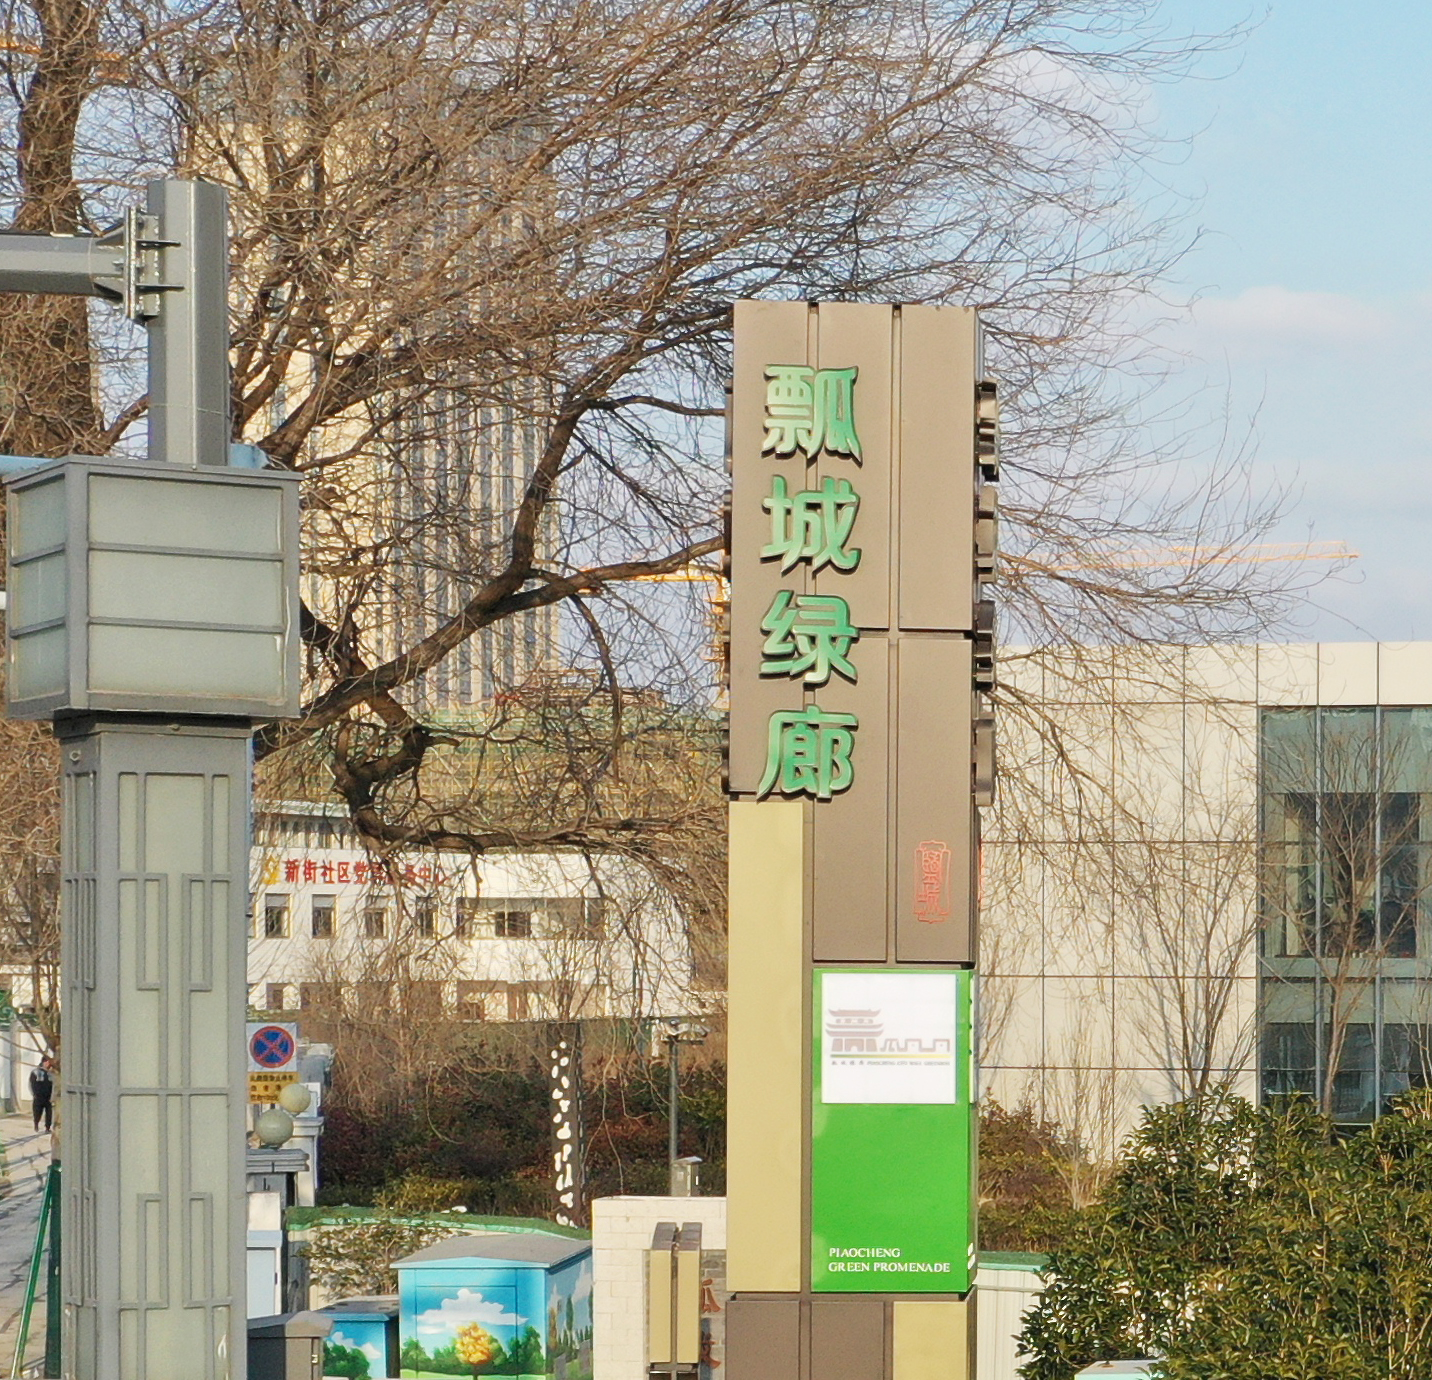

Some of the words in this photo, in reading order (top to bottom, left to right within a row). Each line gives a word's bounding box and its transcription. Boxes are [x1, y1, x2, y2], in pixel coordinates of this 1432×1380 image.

[756, 363, 863, 800] 瓢城绿廊
[828, 1247, 901, 1258] PIAOCHENG
[828, 1261, 870, 1272] GREEN
[873, 1262, 951, 1273] PROMENADE
